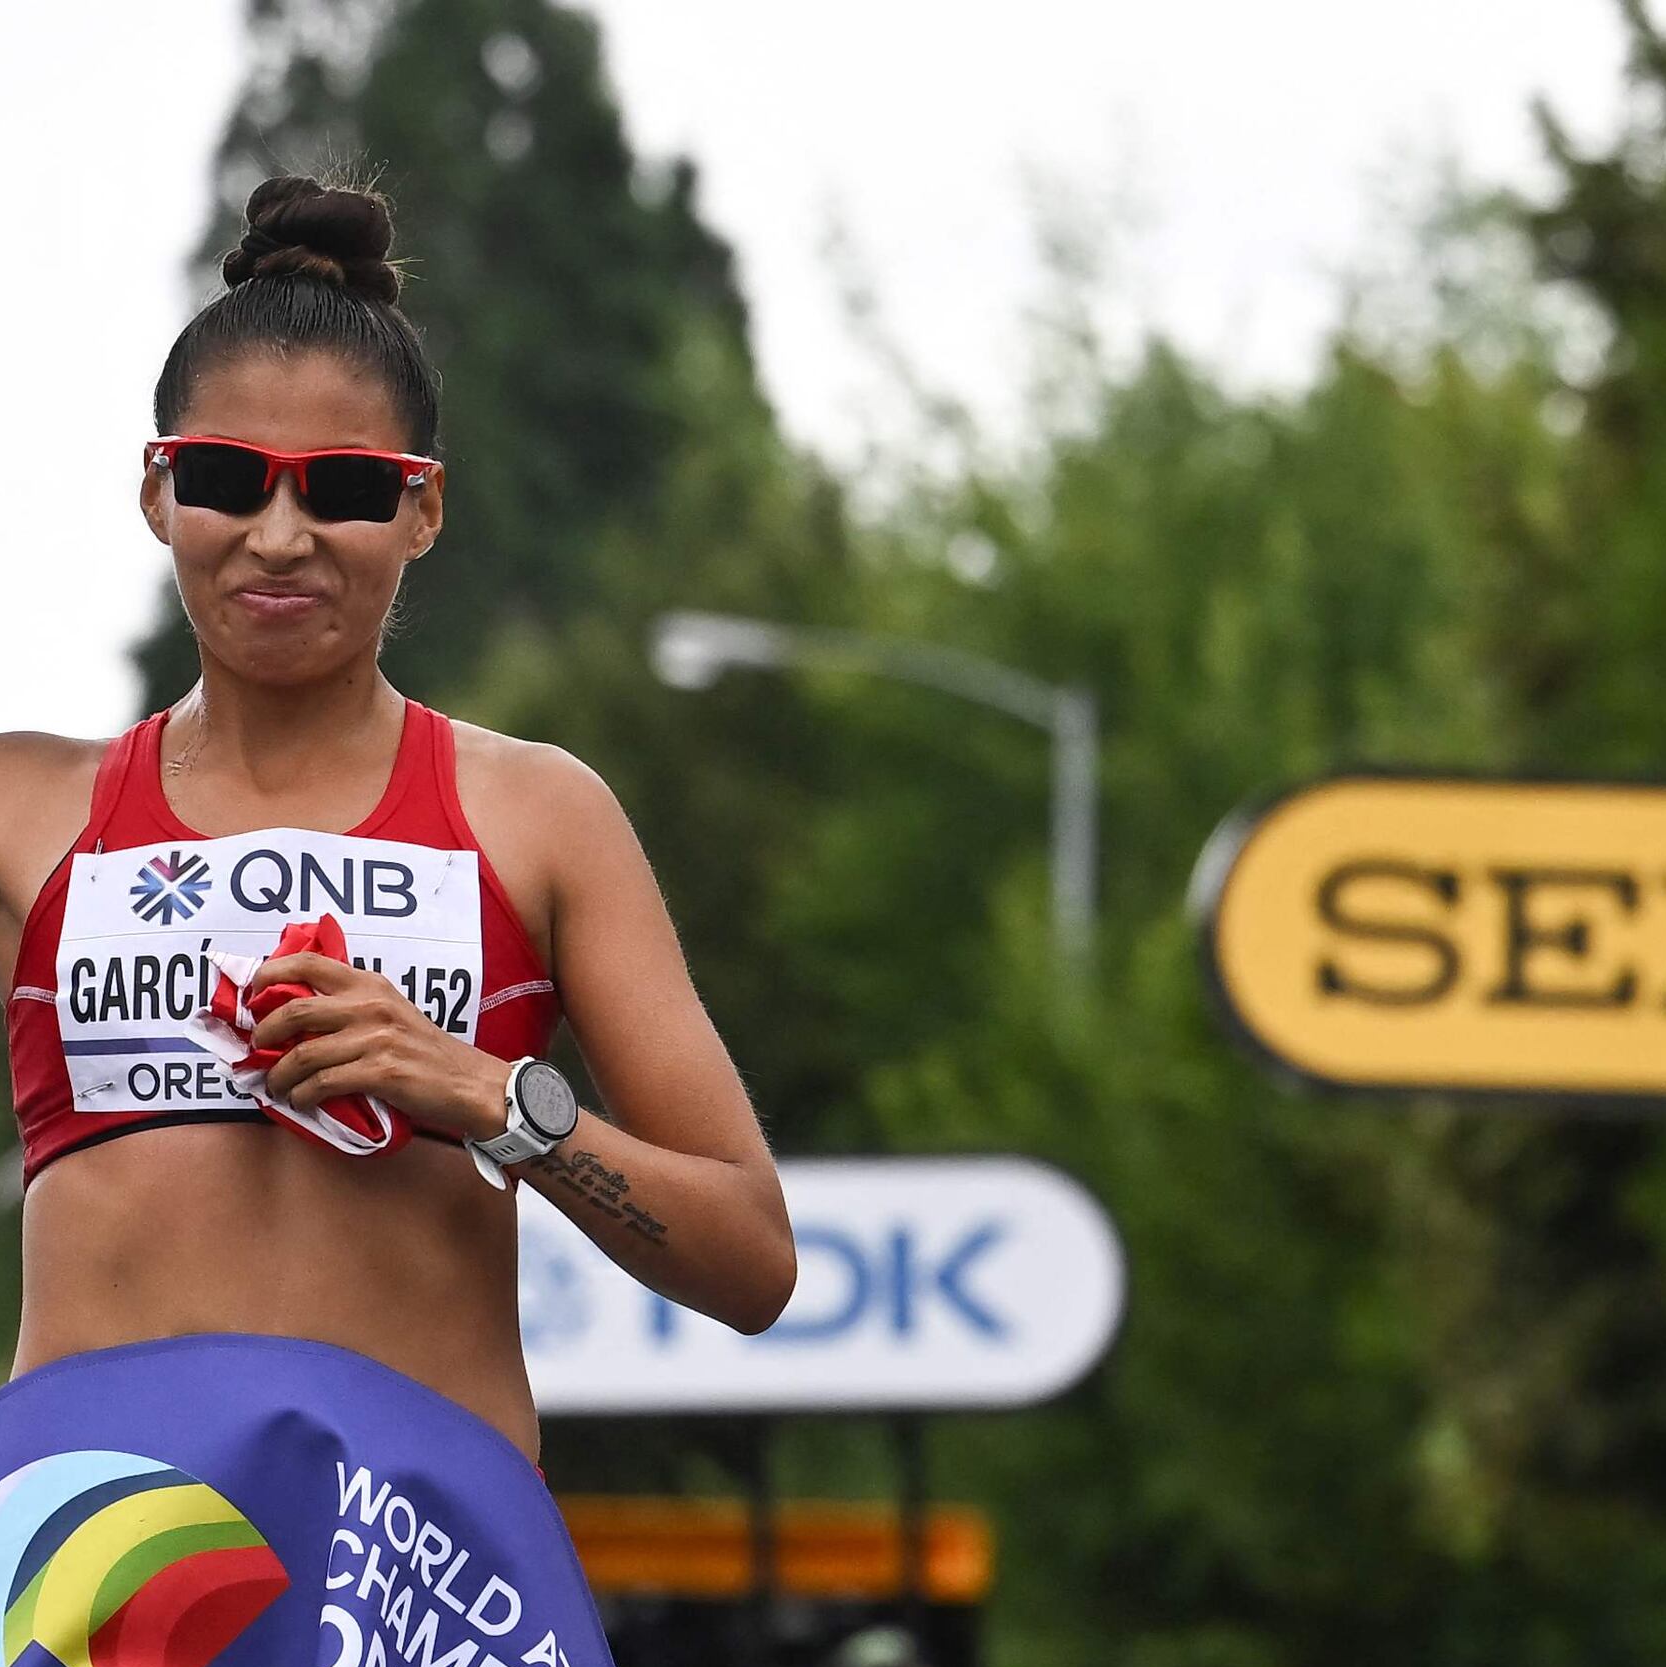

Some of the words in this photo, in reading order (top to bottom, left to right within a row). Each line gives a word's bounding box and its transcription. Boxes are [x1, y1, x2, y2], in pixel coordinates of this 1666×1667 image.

[231, 850, 418, 917] QNB
[71, 938, 211, 1025] GARCÍ
[401, 964, 472, 1033] 152
[336, 1461, 523, 1637] WORLD
